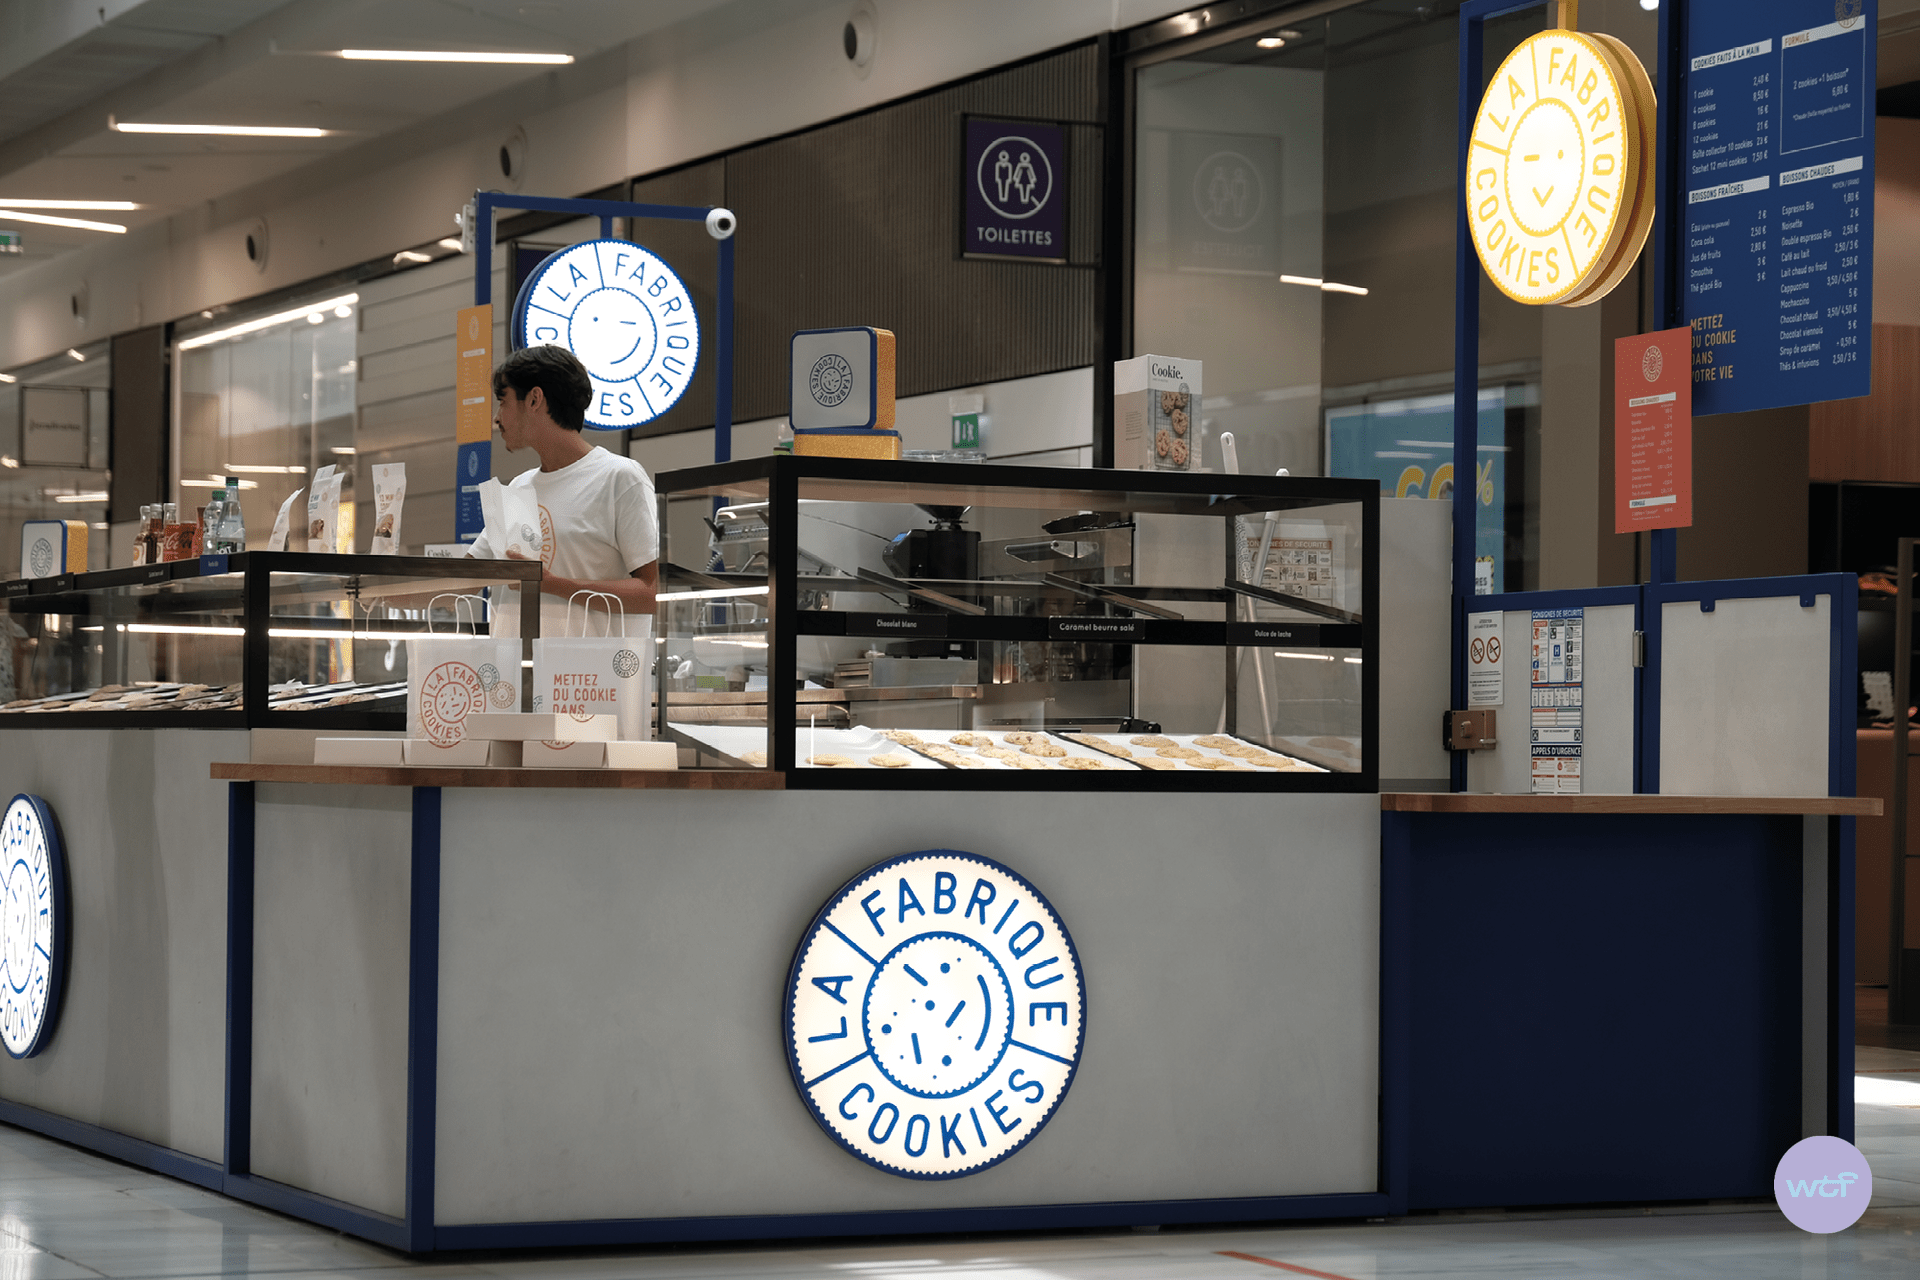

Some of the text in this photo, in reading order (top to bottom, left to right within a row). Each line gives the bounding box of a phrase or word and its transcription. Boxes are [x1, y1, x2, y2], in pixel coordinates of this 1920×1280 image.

[1785, 32, 1810, 47] FORMULE
[1693, 56, 1716, 69] COOKIES
[1717, 53, 1732, 63] FAITS
[1738, 50, 1745, 58] LA
[1746, 45, 1760, 56] MAIN
[1765, 73, 1770, 82] €
[1793, 81, 1798, 90] 2
[1798, 77, 1818, 89] cookies
[1698, 87, 1714, 98] cookie
[1764, 89, 1770, 98] €
[1844, 84, 1848, 93] €
[1488, 74, 1526, 132] LA
[1698, 102, 1716, 114] cookies
[1764, 104, 1769, 114] €
[1697, 118, 1716, 129] cookies
[1764, 120, 1768, 130] €
[1693, 132, 1718, 144] 12 cookies
[1548, 47, 1615, 248] FABRIQUE
[1706, 144, 1728, 157] collector
[1728, 142, 1734, 151] 10
[1734, 139, 1754, 150] cookies
[1764, 136, 1768, 144] €
[1692, 163, 1710, 174] Sachet
[1710, 161, 1716, 170] 12
[1717, 158, 1728, 170] mini
[1728, 156, 1748, 167] cookies
[1764, 150, 1768, 160] €
[1782, 165, 1835, 184] BOISSONS CHAUDES
[1692, 182, 1744, 202] BOISSONS FRAÎCHES
[1855, 191, 1860, 200] €
[1762, 209, 1767, 218] €
[1782, 202, 1814, 218] Espresso Bio
[1854, 207, 1860, 216] €
[1476, 167, 1560, 287] COOKIES
[1691, 222, 1701, 232] Eau
[1762, 225, 1766, 234] €
[1782, 219, 1804, 232] Noisette
[1854, 224, 1859, 233] €
[977, 226, 1053, 246] TOILETTES
[1690, 236, 1714, 248] Coca cola
[1782, 230, 1832, 246] Double espresso Bio
[1762, 240, 1766, 250] €
[1690, 250, 1722, 263] Jus de fruits
[1762, 256, 1766, 266] €
[1781, 248, 1810, 262] Café au lait
[1854, 256, 1858, 265] €
[1690, 266, 1714, 278] Smoothie
[1762, 272, 1766, 280] €
[1781, 267, 1790, 278] Lait
[1791, 264, 1806, 276] chaud
[1814, 262, 1828, 272] froid
[1854, 272, 1858, 281] €
[547, 262, 589, 302] LA
[1690, 279, 1722, 294] Thé glacé Bio
[1781, 282, 1809, 294] Cappuccino
[1853, 288, 1858, 297] €
[1780, 298, 1810, 310] Mochaccino
[1853, 304, 1858, 313] €
[1690, 314, 1724, 332] METTEZ
[1780, 310, 1819, 325] Chocolat chaud
[614, 252, 690, 398] FABRIQUE
[1853, 320, 1858, 329] €
[1705, 330, 1737, 347] COOKIE
[1780, 326, 1824, 340] Chocolat viennois
[1852, 336, 1857, 346] €
[1780, 342, 1821, 357] Sirop de caramel
[837, 360, 847, 373] LA
[1152, 362, 1184, 380] Cookie.
[1780, 362, 1791, 372] Thés
[1797, 357, 1819, 369] infusions
[811, 357, 833, 390] COOKIES
[1719, 364, 1734, 380] VIE
[817, 379, 851, 405] FABRIQUE
[1532, 610, 1556, 618] CONSIGNES
[1556, 610, 1562, 618] DE
[876, 619, 918, 630] Chocolat blanc
[1059, 622, 1135, 633] Caramel beurre salé
[1254, 630, 1292, 638] Dulce de leche
[427, 672, 445, 692] LA
[554, 674, 598, 686] METTEZ
[553, 688, 617, 702] DU COOKIE
[552, 704, 586, 714] DANS
[422, 700, 462, 740] COOKIES
[1532, 746, 1582, 756] APPELS D'URGENCE
[2, 811, 49, 931] FABRIQUE
[861, 871, 1068, 1027] FABRIQUE
[808, 975, 854, 1044] LA
[838, 1068, 1046, 1159] COOKIES
